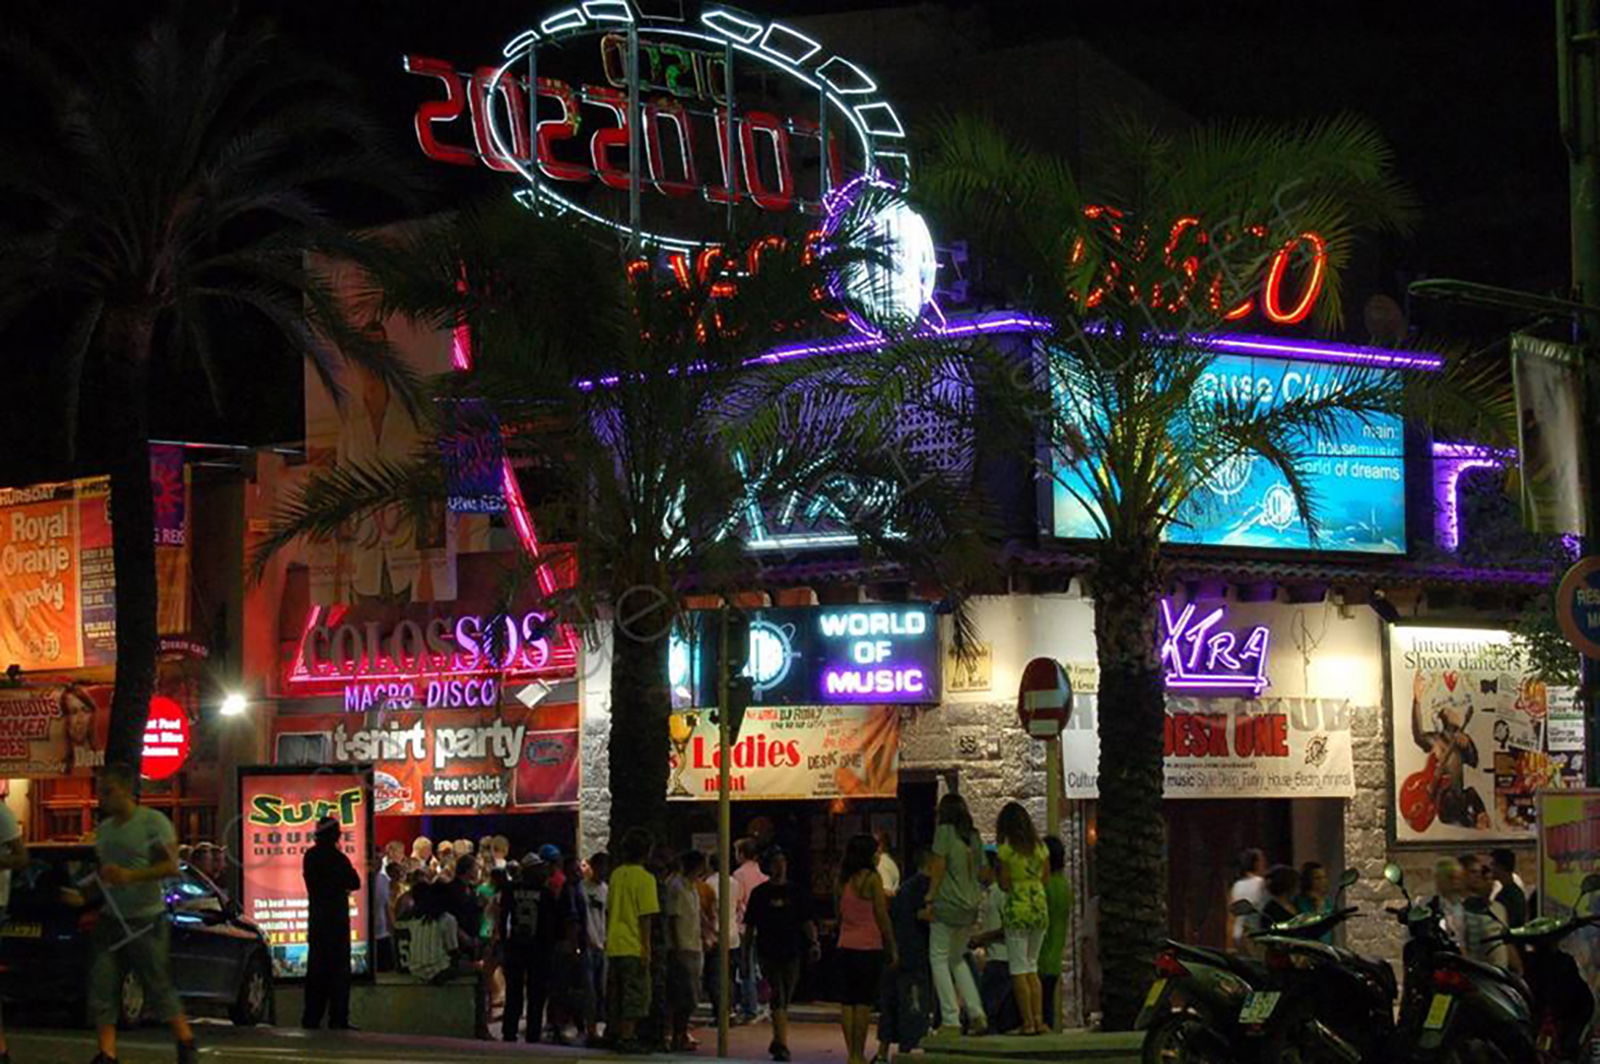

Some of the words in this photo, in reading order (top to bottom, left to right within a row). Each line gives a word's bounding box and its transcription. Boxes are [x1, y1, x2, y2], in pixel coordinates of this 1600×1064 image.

[1335, 462, 1348, 476] of
[1352, 461, 1400, 479] dreams
[11, 506, 68, 546] Royal
[2, 540, 70, 578] Oranje
[821, 612, 926, 636] WORLD
[305, 612, 549, 670] COLOSSOS
[854, 641, 892, 664] OF
[1160, 598, 1269, 683] XTRA
[1405, 651, 1452, 670] Show
[827, 670, 924, 694] MUSIC
[345, 682, 416, 712] MACRO
[426, 679, 498, 708] DISCO
[335, 719, 426, 763] t-shirt
[434, 719, 525, 769] party
[693, 734, 800, 768] Ladies
[433, 776, 460, 791] free
[463, 775, 500, 791] t-shirt
[705, 773, 746, 792] niht
[250, 787, 362, 827] Surf
[424, 791, 442, 806] for
[445, 790, 508, 808] everybody
[253, 831, 355, 845] LOUNE
